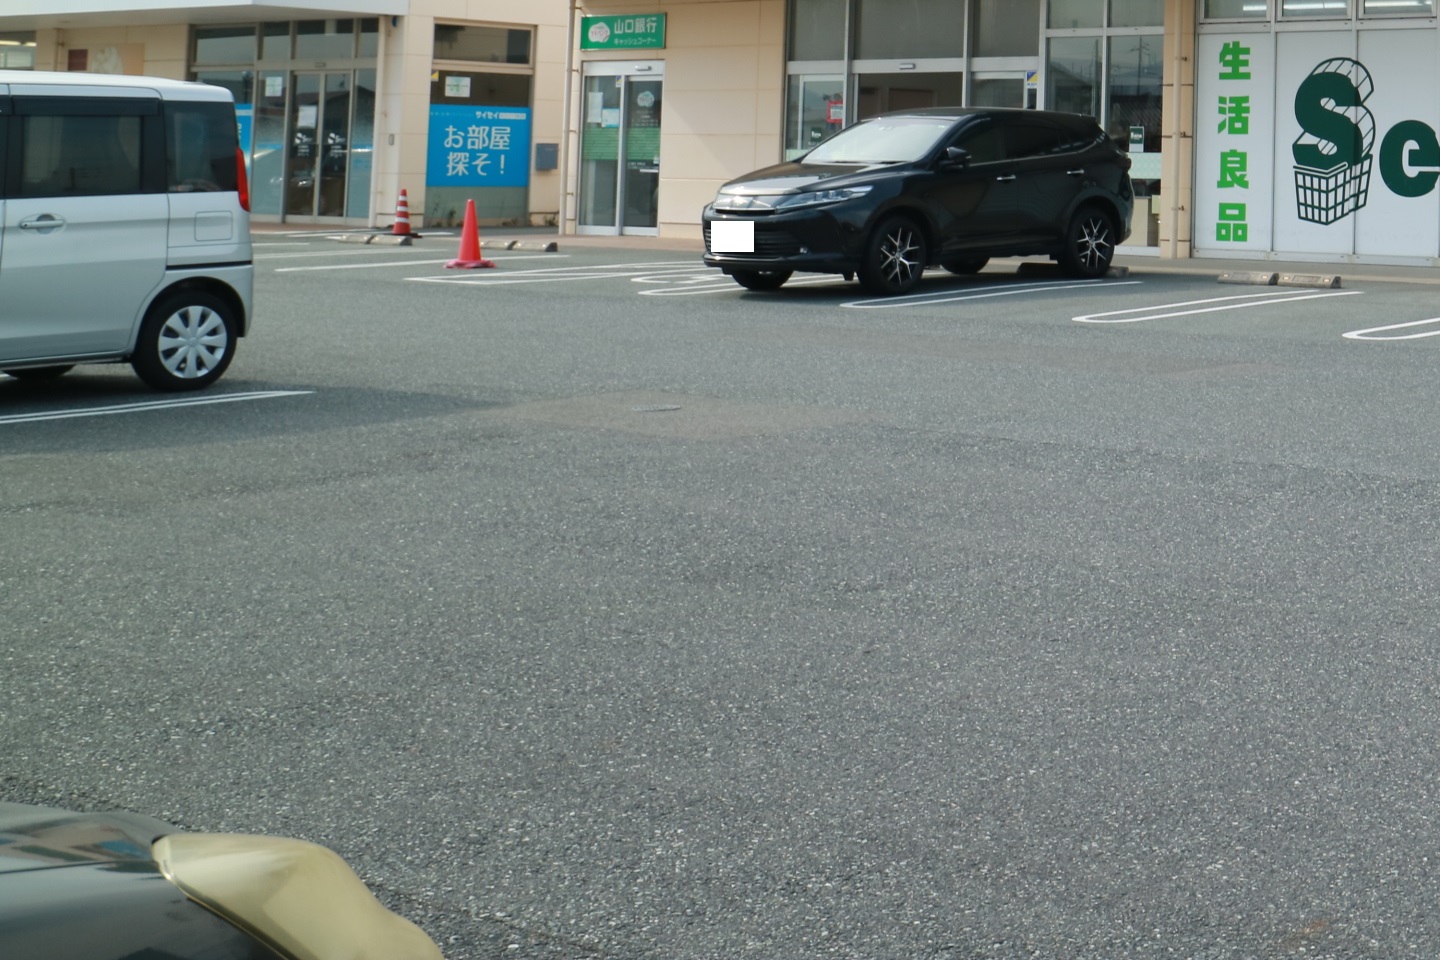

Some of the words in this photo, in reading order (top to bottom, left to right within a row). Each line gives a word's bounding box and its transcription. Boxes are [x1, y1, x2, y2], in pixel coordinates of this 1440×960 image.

[614, 17, 657, 34] 山口銀行
[444, 125, 511, 150] お部屋
[1216, 41, 1251, 242] 生活良品
[446, 152, 505, 176] 探そ！
